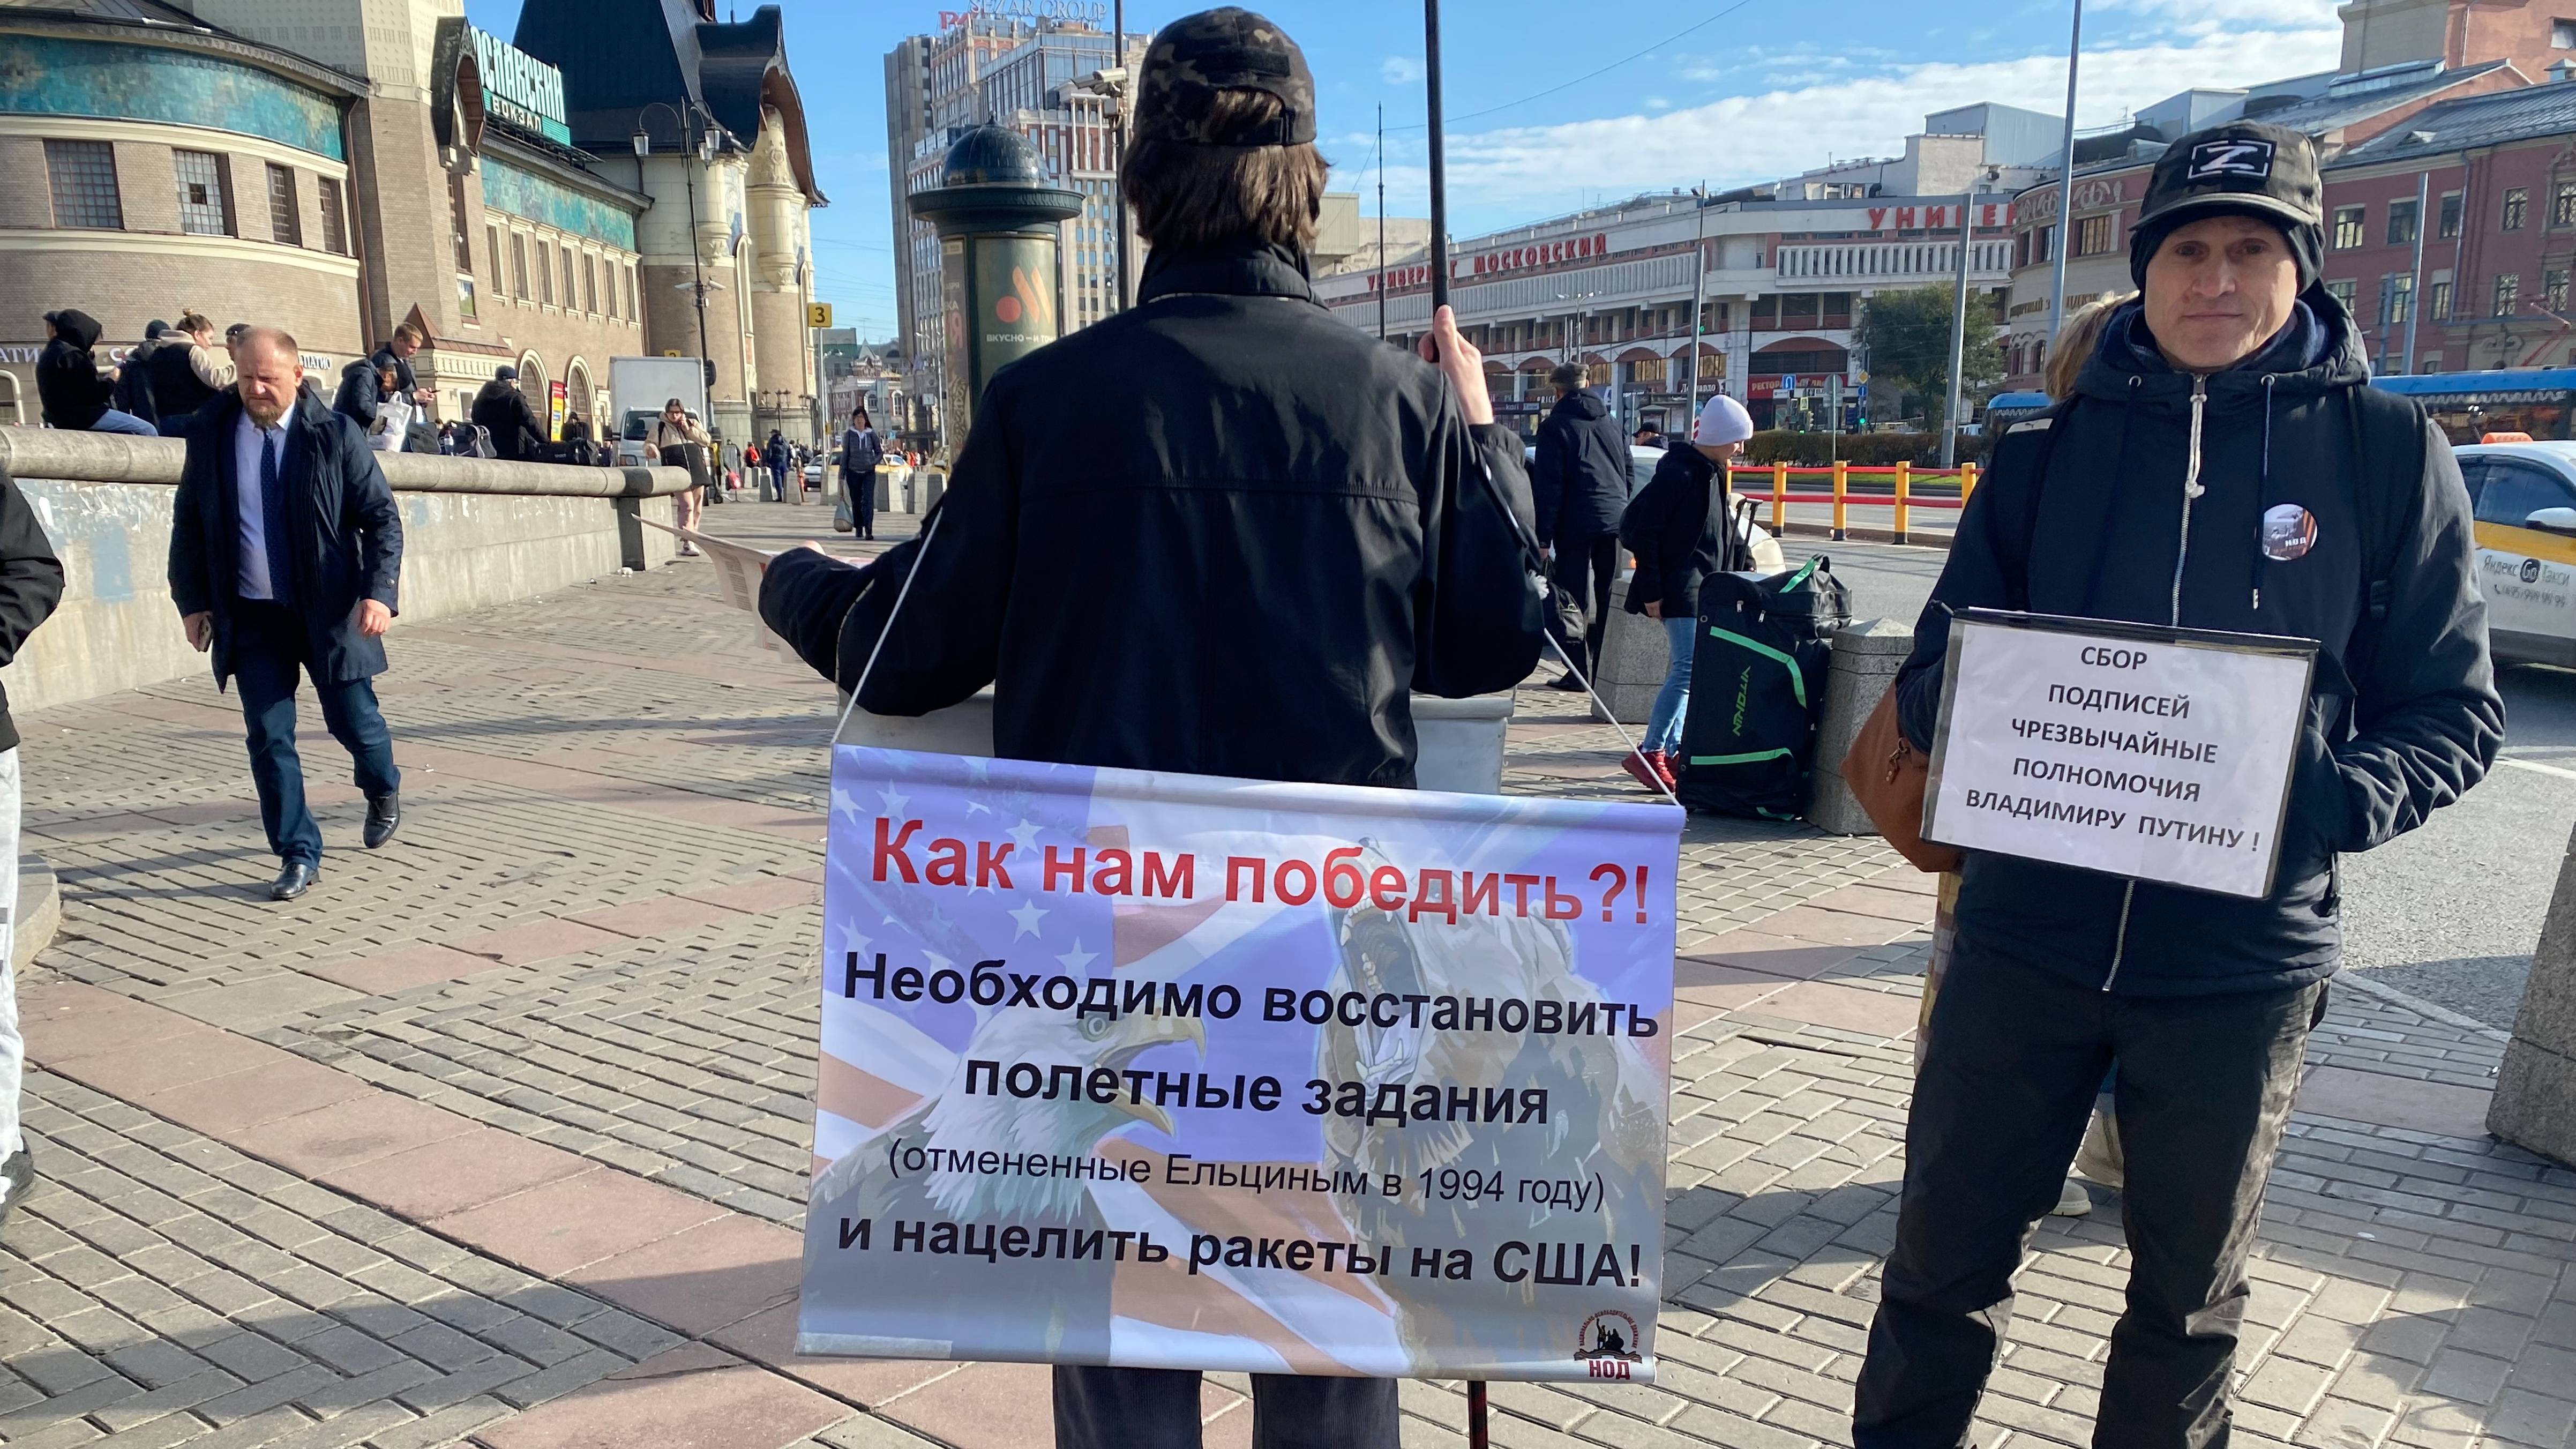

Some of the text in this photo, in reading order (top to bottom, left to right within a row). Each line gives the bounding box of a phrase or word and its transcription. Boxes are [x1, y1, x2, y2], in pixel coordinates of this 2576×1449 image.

[970, 0, 1107, 20] SEZAR GROUP
[470, 26, 566, 124] ОСЛАВСКИЙ
[492, 95, 543, 132] ВОКЗАЛ
[2200, 144, 2259, 172] Z
[1474, 233, 1606, 274] МОСКОВСКИЙ
[815, 307, 825, 323] 3
[0, 347, 39, 363] АТИ
[986, 334, 1024, 342] ВКУСНО
[1033, 334, 1039, 343] И
[2483, 555, 2570, 587] Яндекс Go Такси
[2081, 646, 2147, 670] СБОР
[2049, 684, 2190, 719] ПОДПИСЕЙ
[2012, 718, 2218, 764] ЧРЕЗВЫЧАЙНЫЕ
[2013, 758, 2200, 802] ПОЛНОМОЧИЯ
[1966, 789, 2126, 830] ВЛАДИМИРУ
[2138, 816, 2243, 848] ПУТИНУ
[873, 818, 1650, 925] Как нам победить?!
[844, 952, 1658, 1038] Необходимо восстановить
[965, 1060, 1548, 1129] полетные задания
[889, 1138, 1604, 1213] (отмененные Ельциным в 1994 году)
[839, 1218, 1641, 1288] и нацелить ракеты на США!
[1589, 1360, 1631, 1380] НОД
